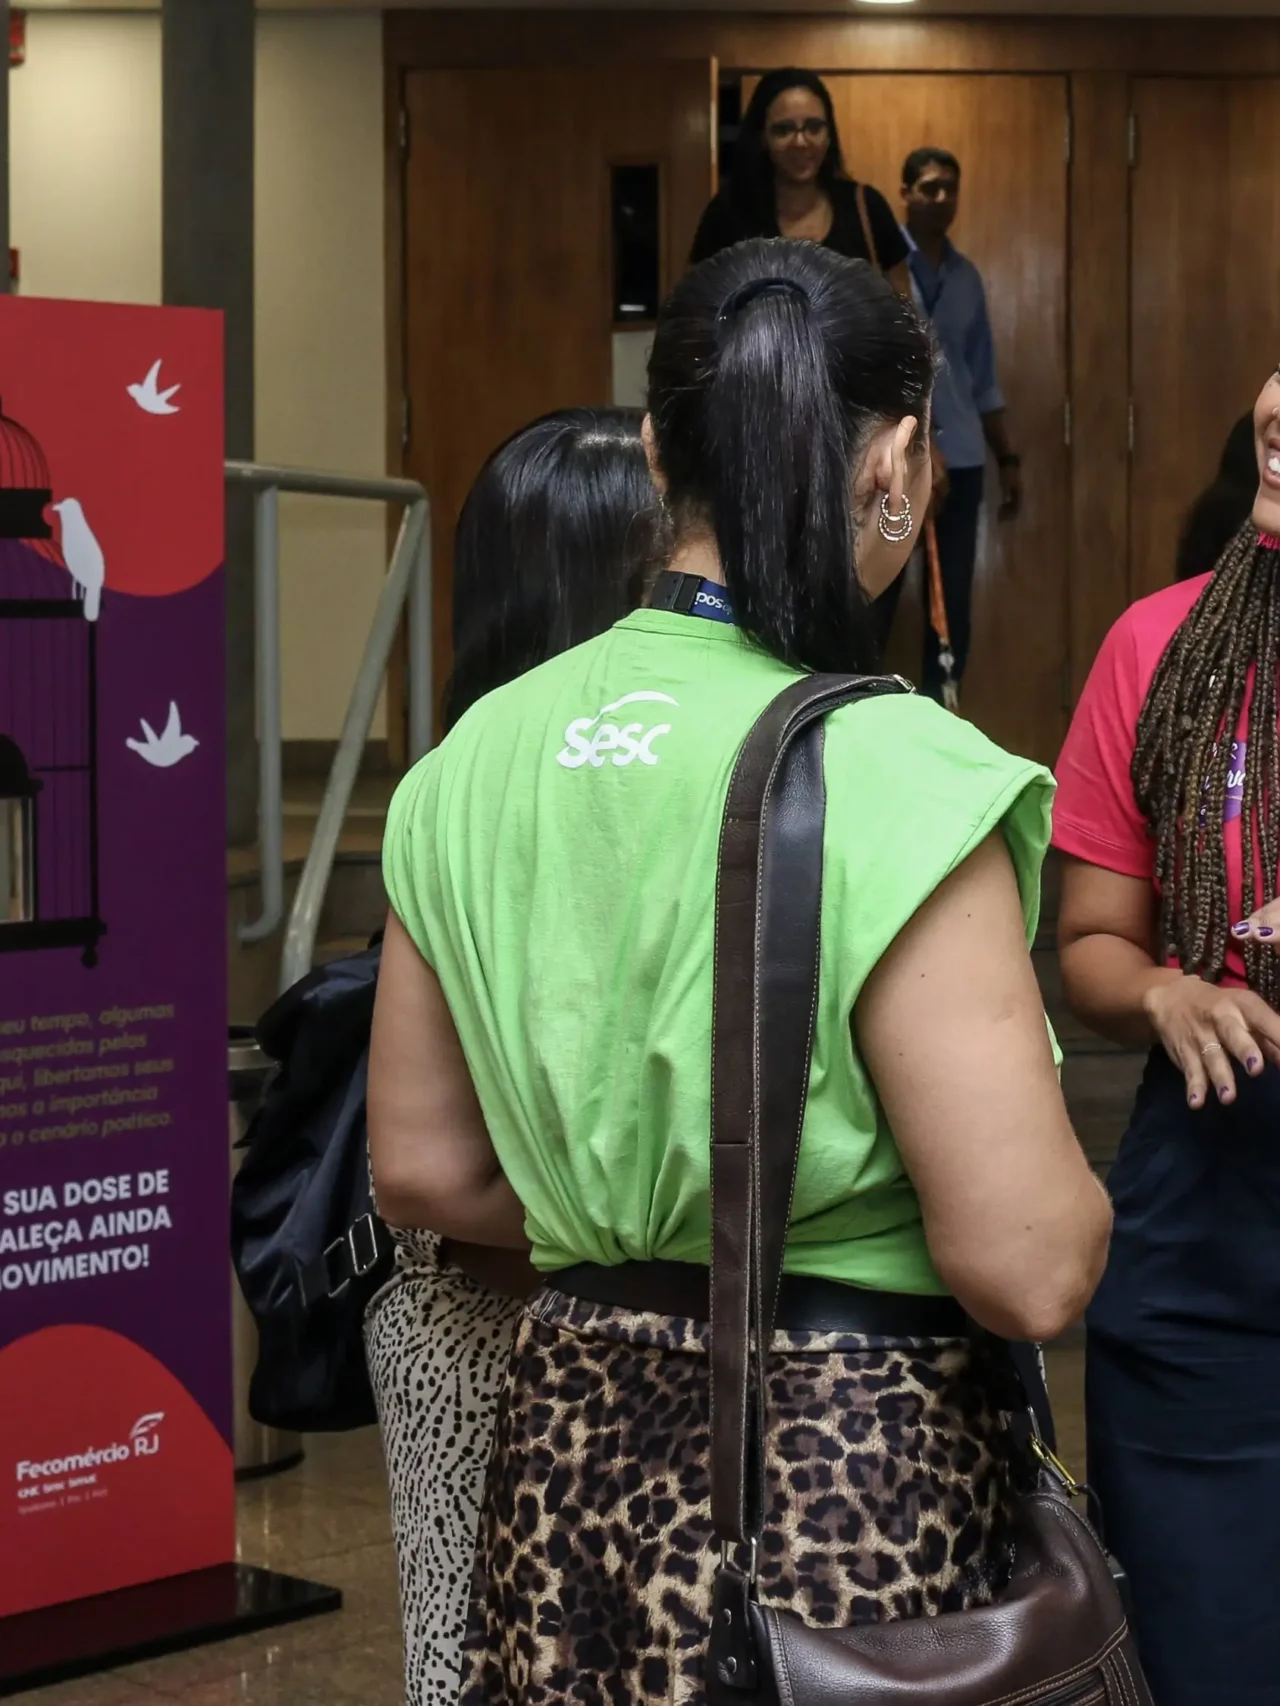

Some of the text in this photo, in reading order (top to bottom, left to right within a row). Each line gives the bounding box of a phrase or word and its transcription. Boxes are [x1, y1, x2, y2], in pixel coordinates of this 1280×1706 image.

[556, 712, 674, 768] sesc
[3, 1169, 169, 1216] SUA DOSE DE
[0, 1205, 173, 1253] ALEÇA AINDA
[0, 1244, 149, 1291] OVIMENTO!
[16, 1433, 160, 1482] Fecomércio RJ
